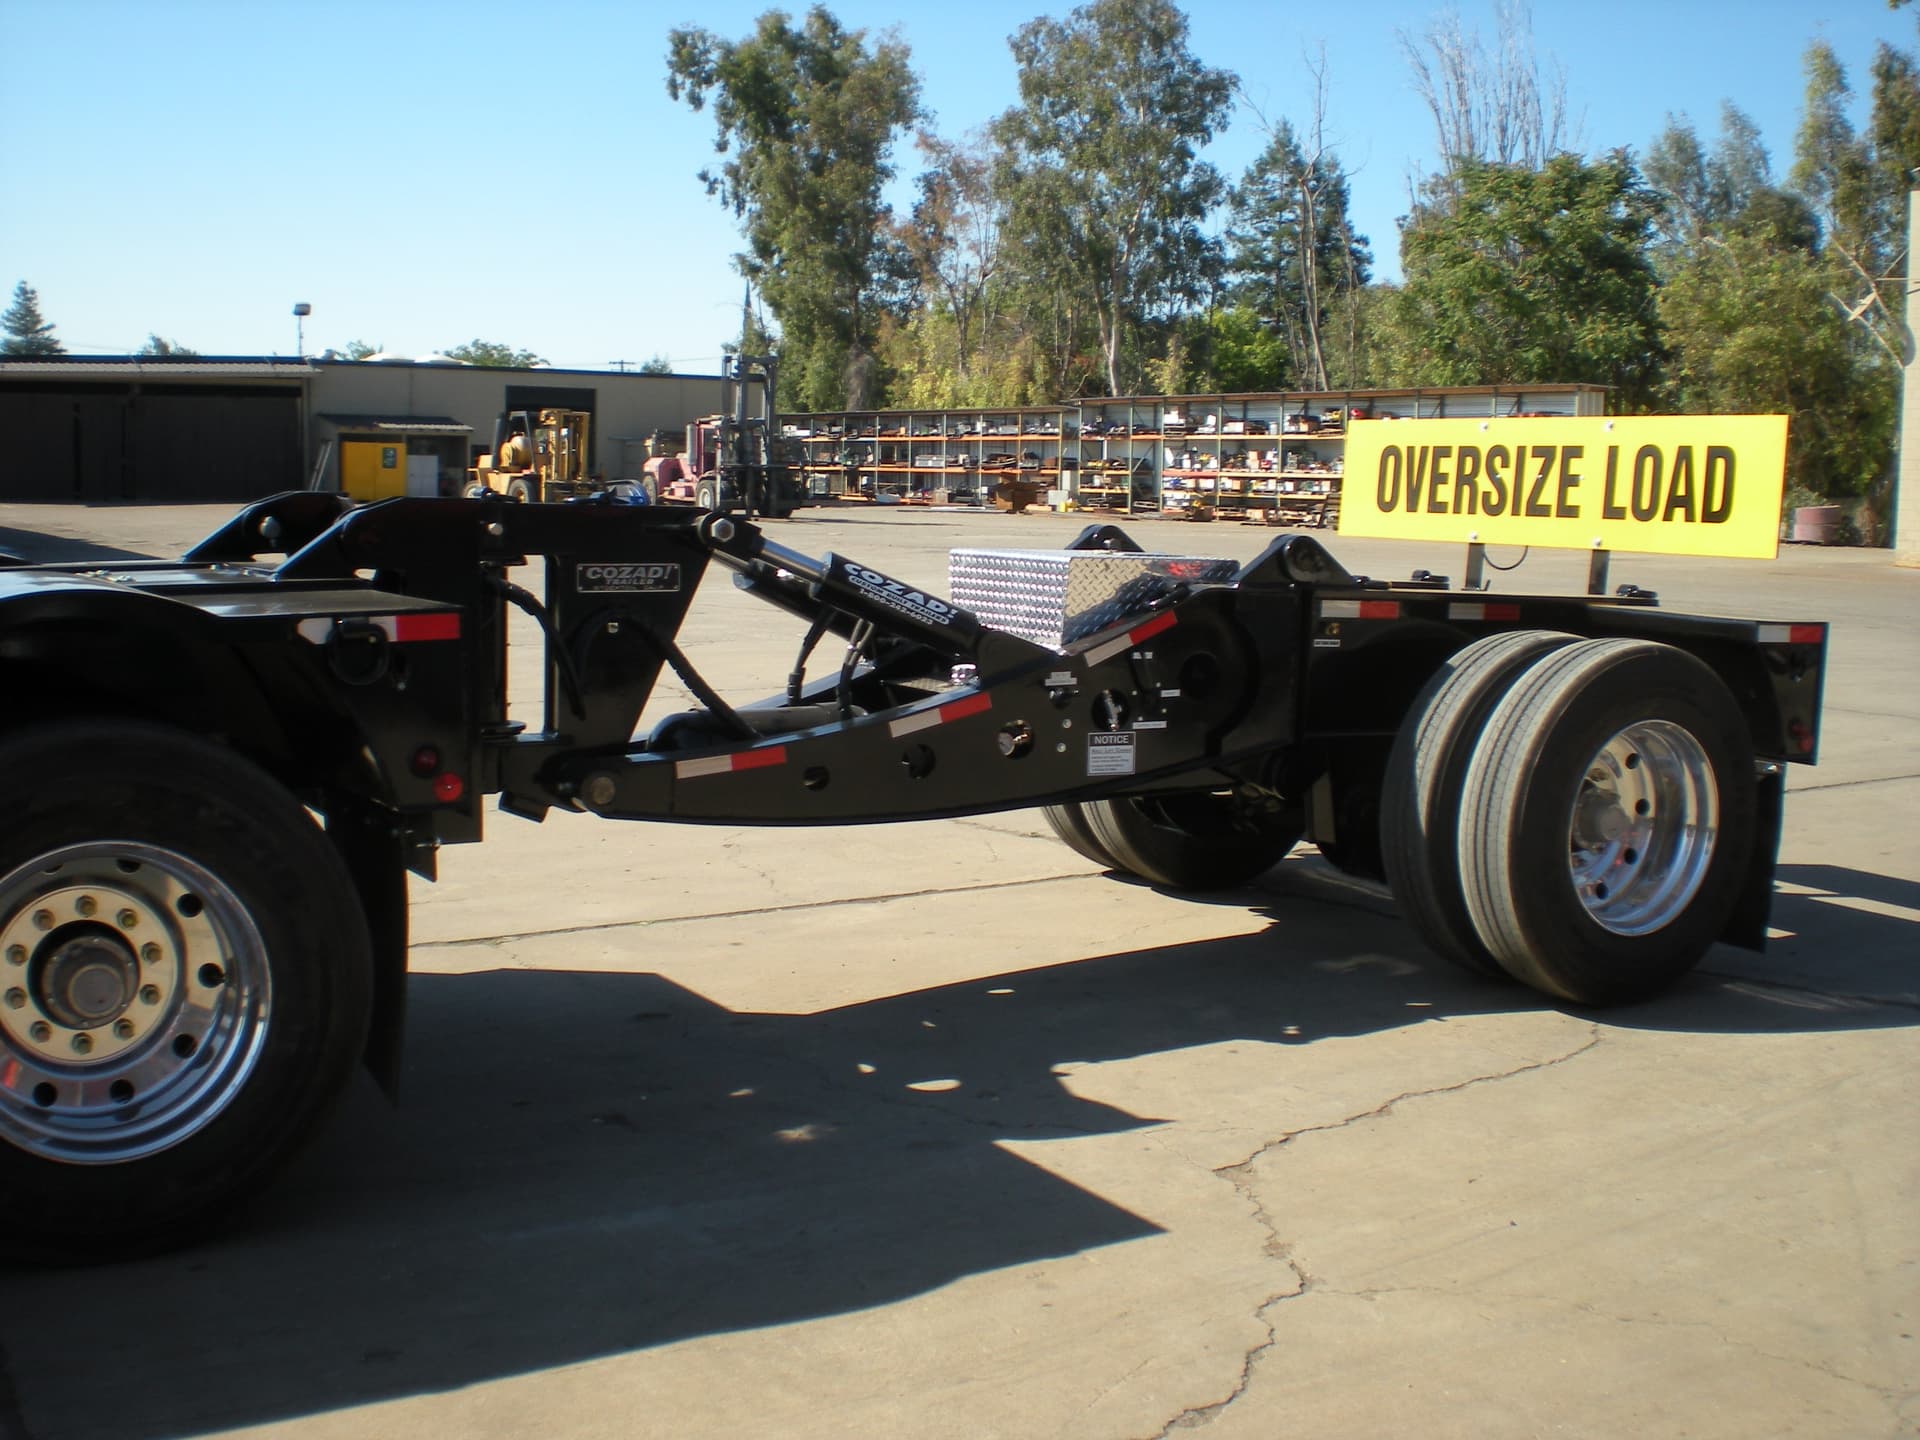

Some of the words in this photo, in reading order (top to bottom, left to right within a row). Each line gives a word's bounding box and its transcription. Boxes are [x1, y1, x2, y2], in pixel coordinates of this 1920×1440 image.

[1377, 444, 1585, 518] OVERSIZE
[1602, 444, 1737, 523] LOAD
[1094, 735, 1129, 744] NOTICE
